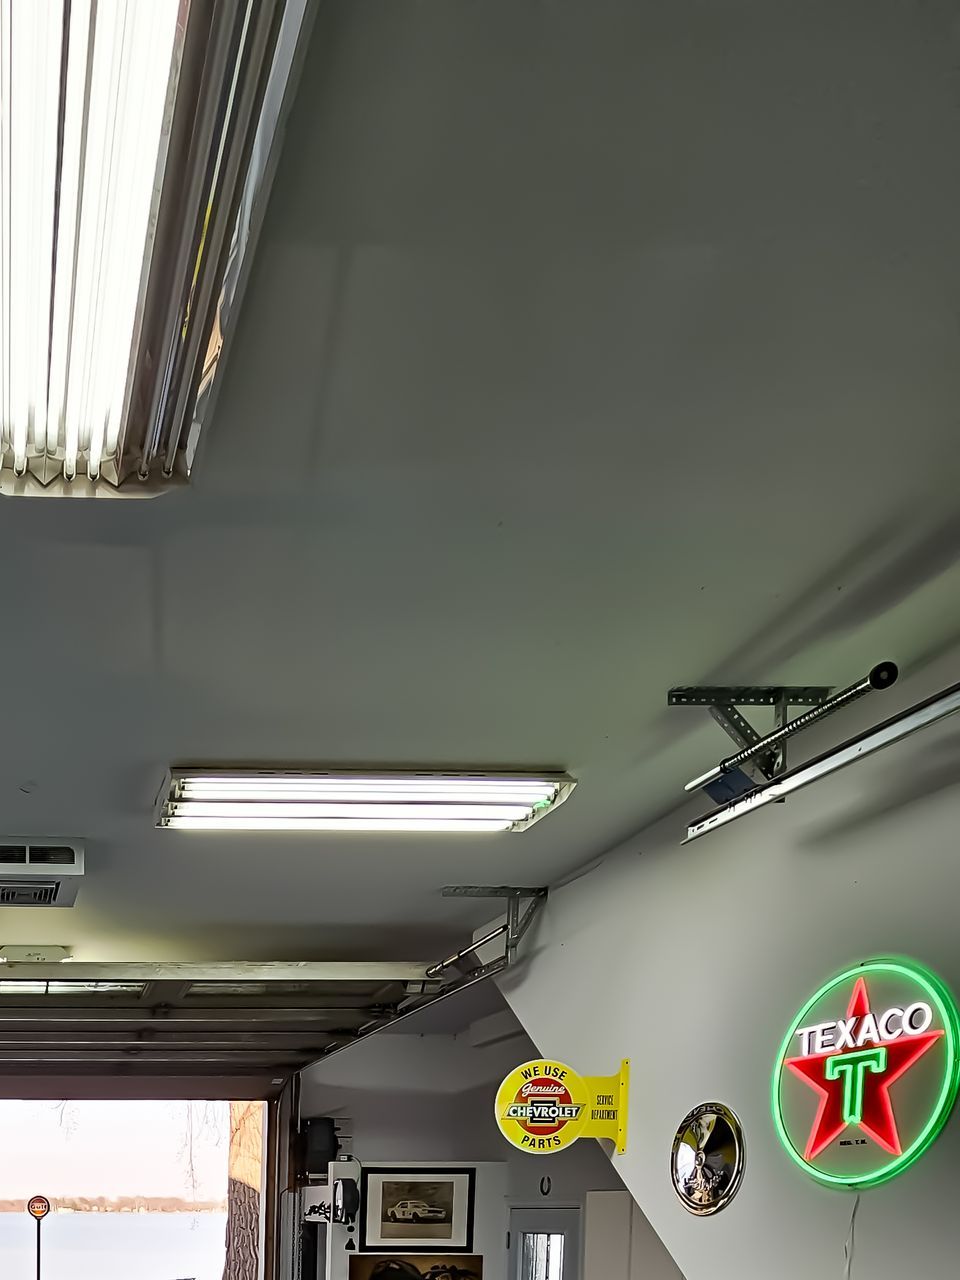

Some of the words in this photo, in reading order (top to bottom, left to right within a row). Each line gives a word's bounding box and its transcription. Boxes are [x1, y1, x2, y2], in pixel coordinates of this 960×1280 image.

[796, 1002, 933, 1056] TEXACO
[521, 1066, 540, 1080] WE
[544, 1066, 567, 1080] USE
[522, 1083, 566, 1097] Genuine
[825, 1047, 887, 1124] T
[596, 1095, 614, 1106] SERVICE
[509, 1106, 578, 1118] CHEVROLET
[591, 1109, 618, 1121] DEPARTMENT
[521, 1135, 561, 1149] PARTS
